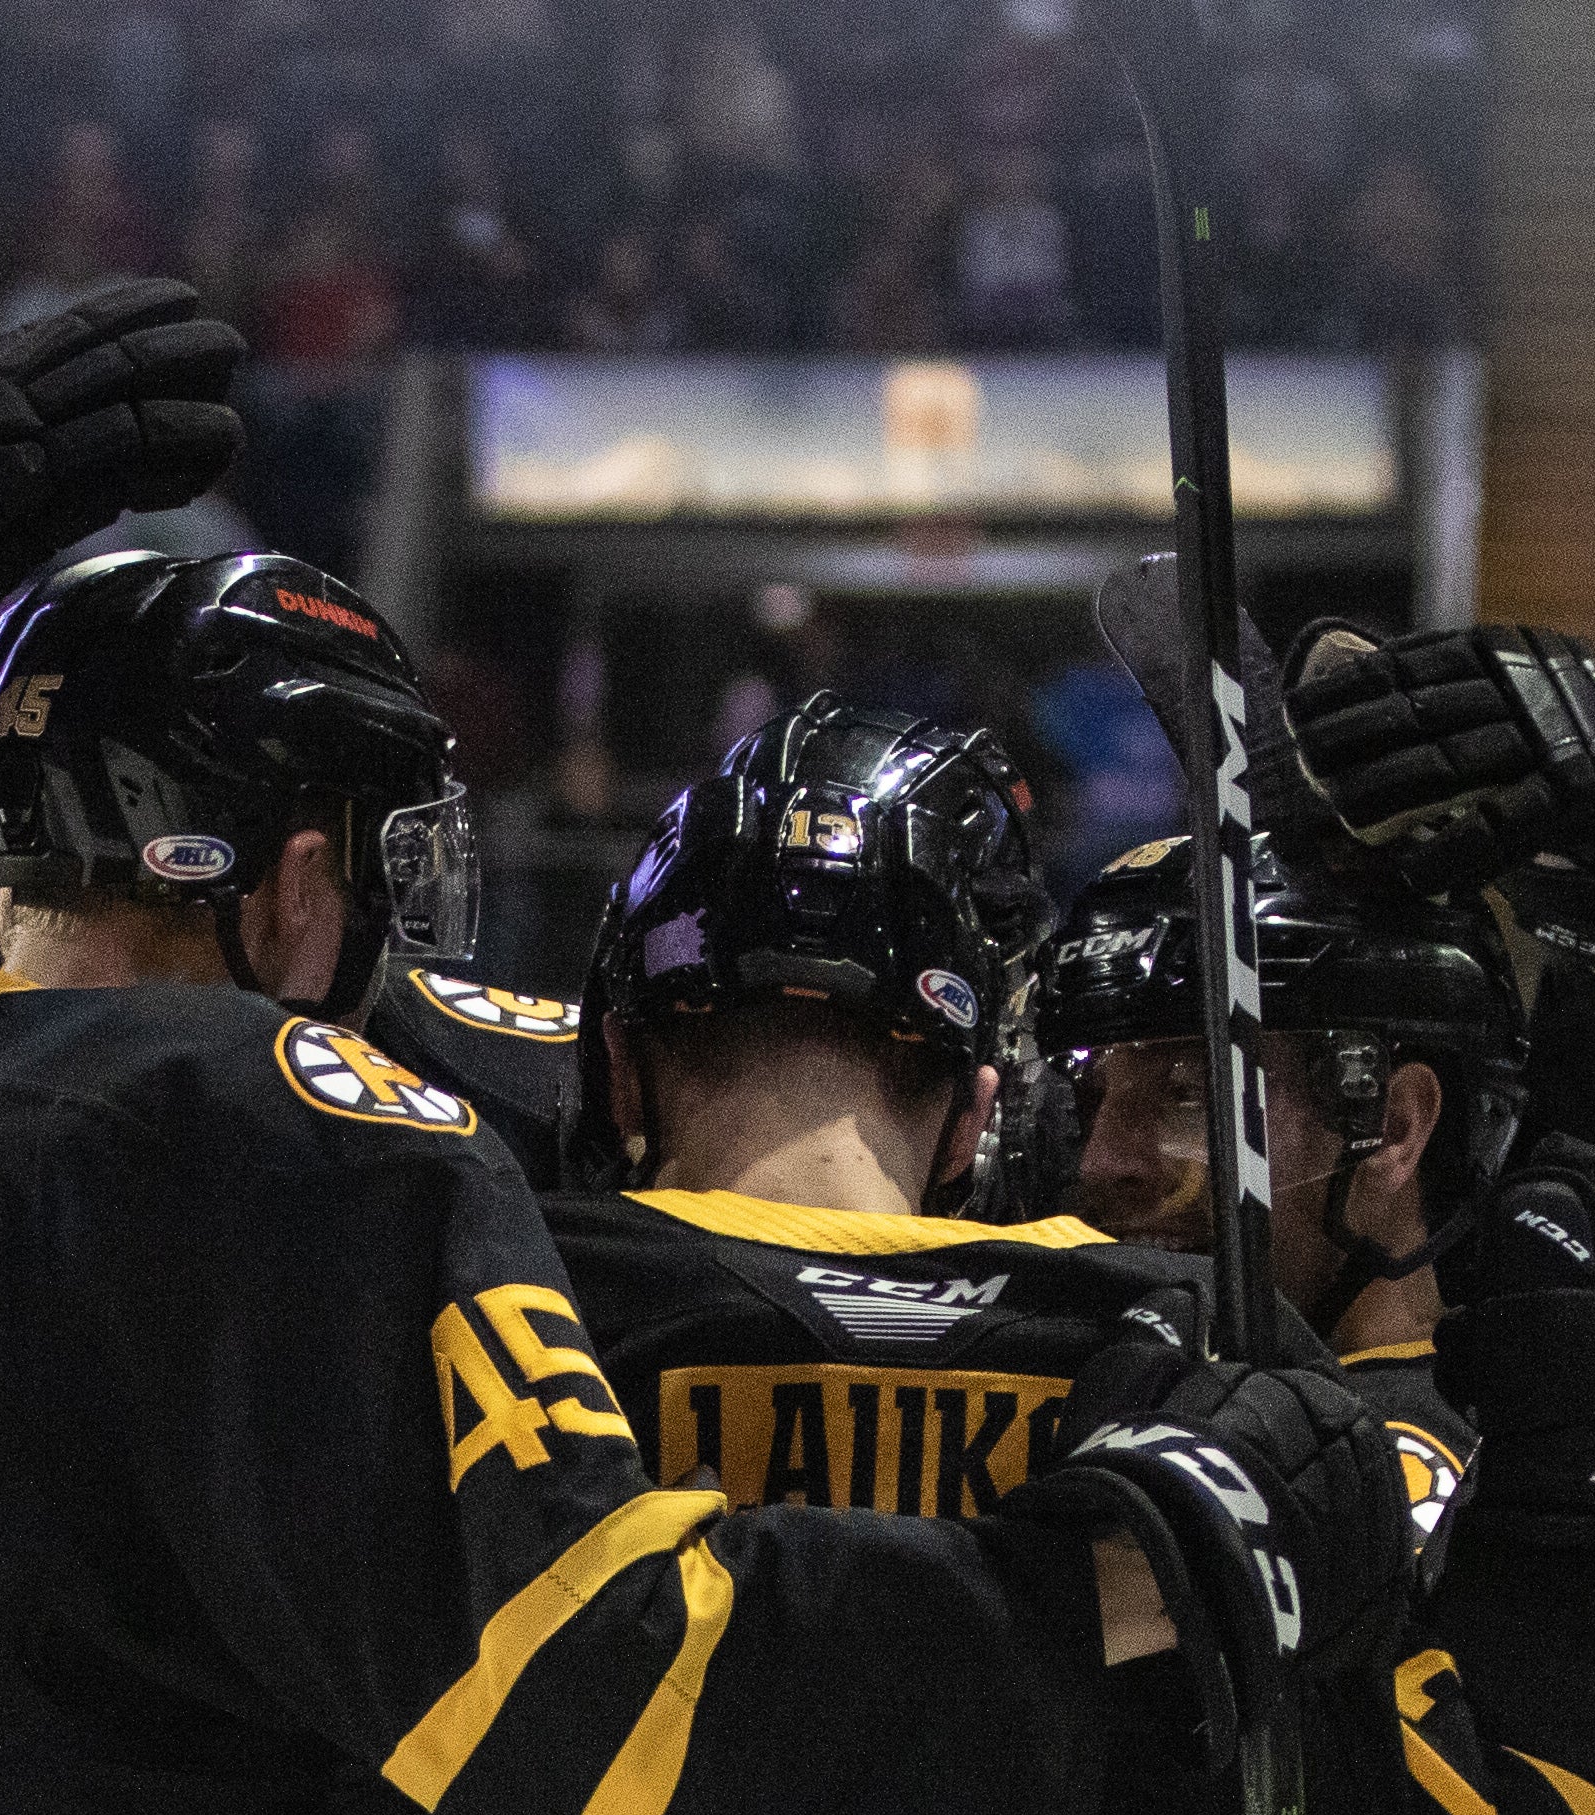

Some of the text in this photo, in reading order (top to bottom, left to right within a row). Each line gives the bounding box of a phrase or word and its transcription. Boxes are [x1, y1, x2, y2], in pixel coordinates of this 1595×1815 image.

[787, 810, 861, 853] 13
[167, 845, 222, 867] AHL
[1057, 927, 1155, 965] CCM
[1211, 658, 1274, 1214] CCM
[1515, 1210, 1591, 1262] CCM
[795, 1265, 1011, 1305] CCM
[1121, 1307, 1182, 1348] CCM
[431, 1283, 638, 1494] 45
[1069, 1423, 1302, 1657] CCM
